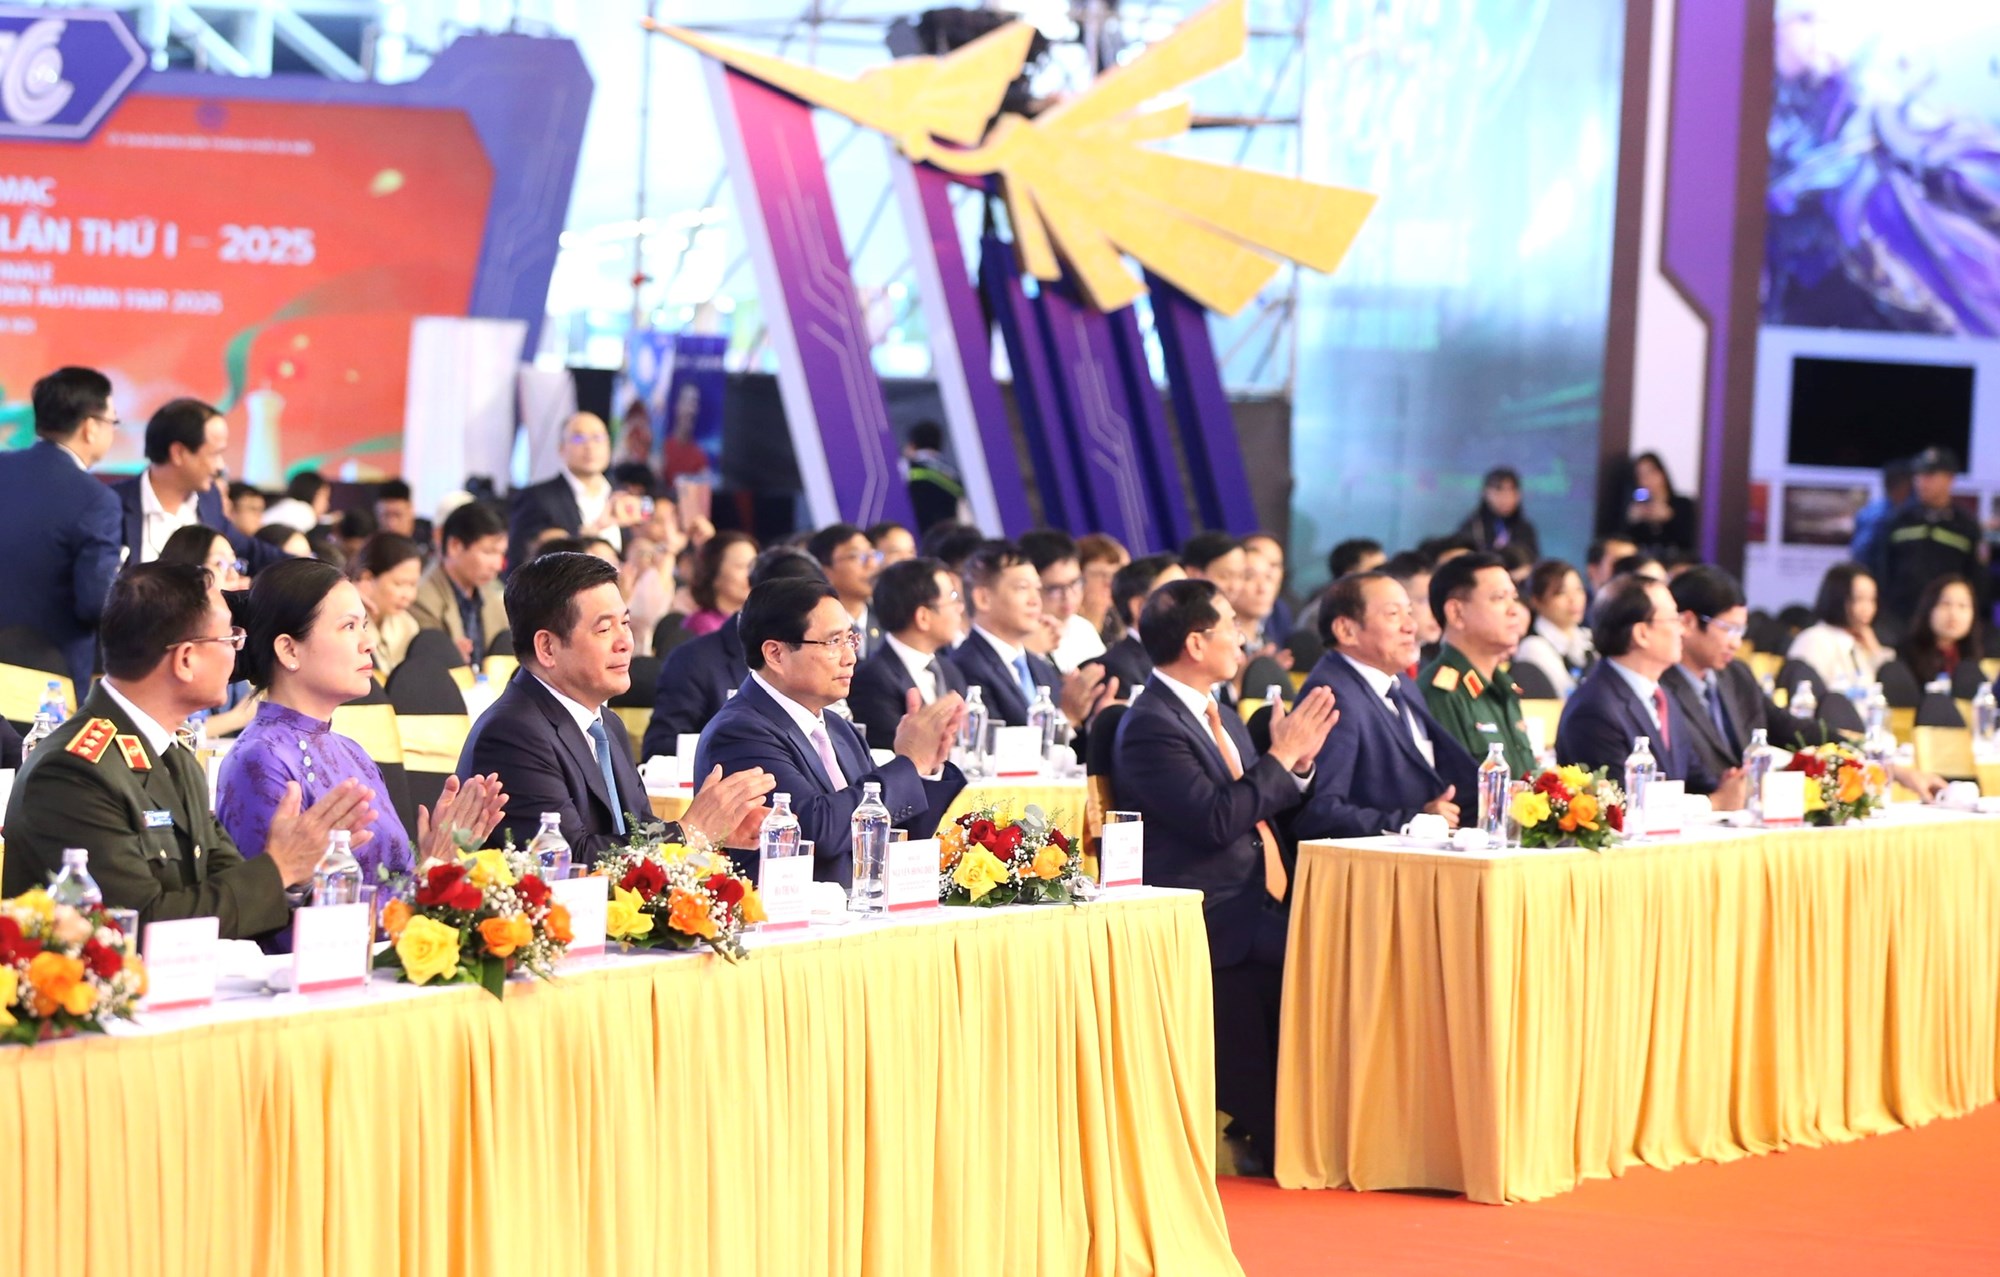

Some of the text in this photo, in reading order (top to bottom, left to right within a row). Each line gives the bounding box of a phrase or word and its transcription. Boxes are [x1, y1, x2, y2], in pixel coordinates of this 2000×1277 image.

[218, 223, 317, 266] 2025
[38, 285, 121, 311] AUTUMN
[124, 288, 168, 312] FAIR
[172, 289, 223, 315] 2025
